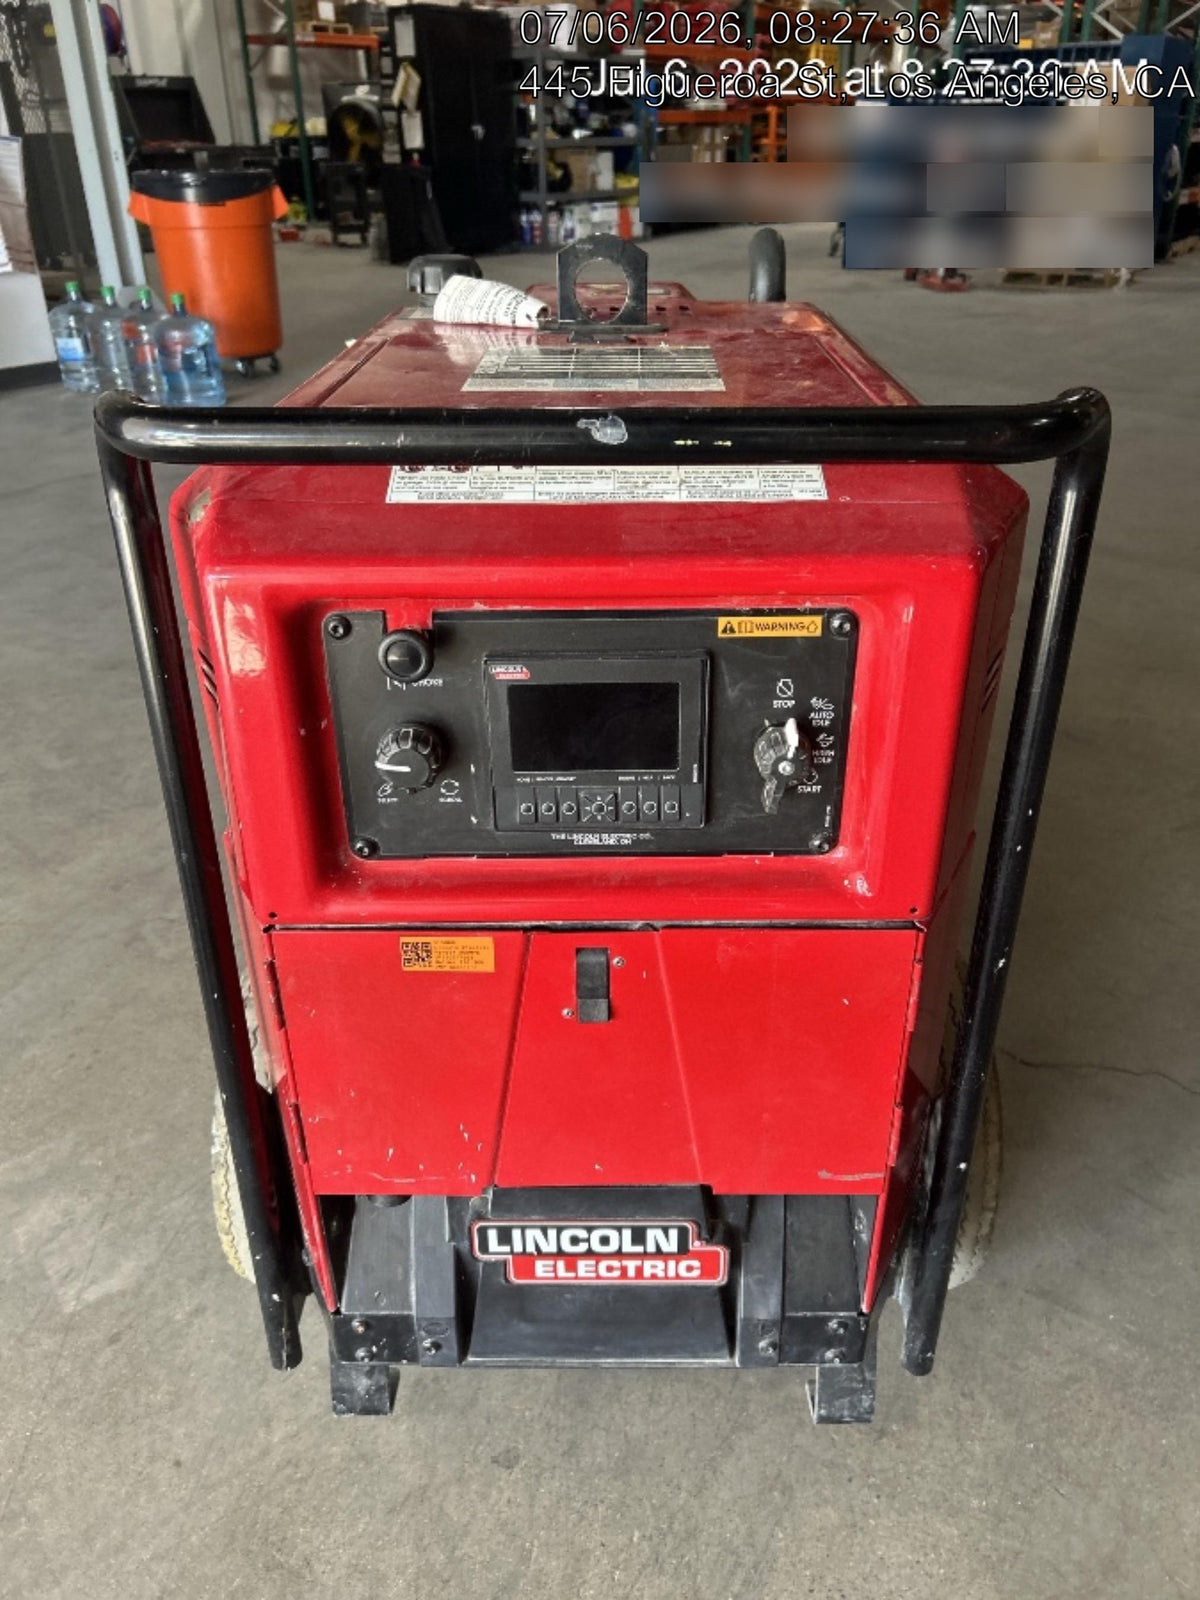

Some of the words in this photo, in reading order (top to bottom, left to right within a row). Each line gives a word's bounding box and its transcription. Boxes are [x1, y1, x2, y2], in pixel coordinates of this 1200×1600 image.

[755, 622, 805, 631] WARNING
[773, 700, 795, 708] STOP
[809, 711, 834, 719] AUTO
[798, 785, 822, 793] START
[487, 1228, 678, 1253] LINCOLN
[534, 1260, 701, 1278] ELECTRIC
